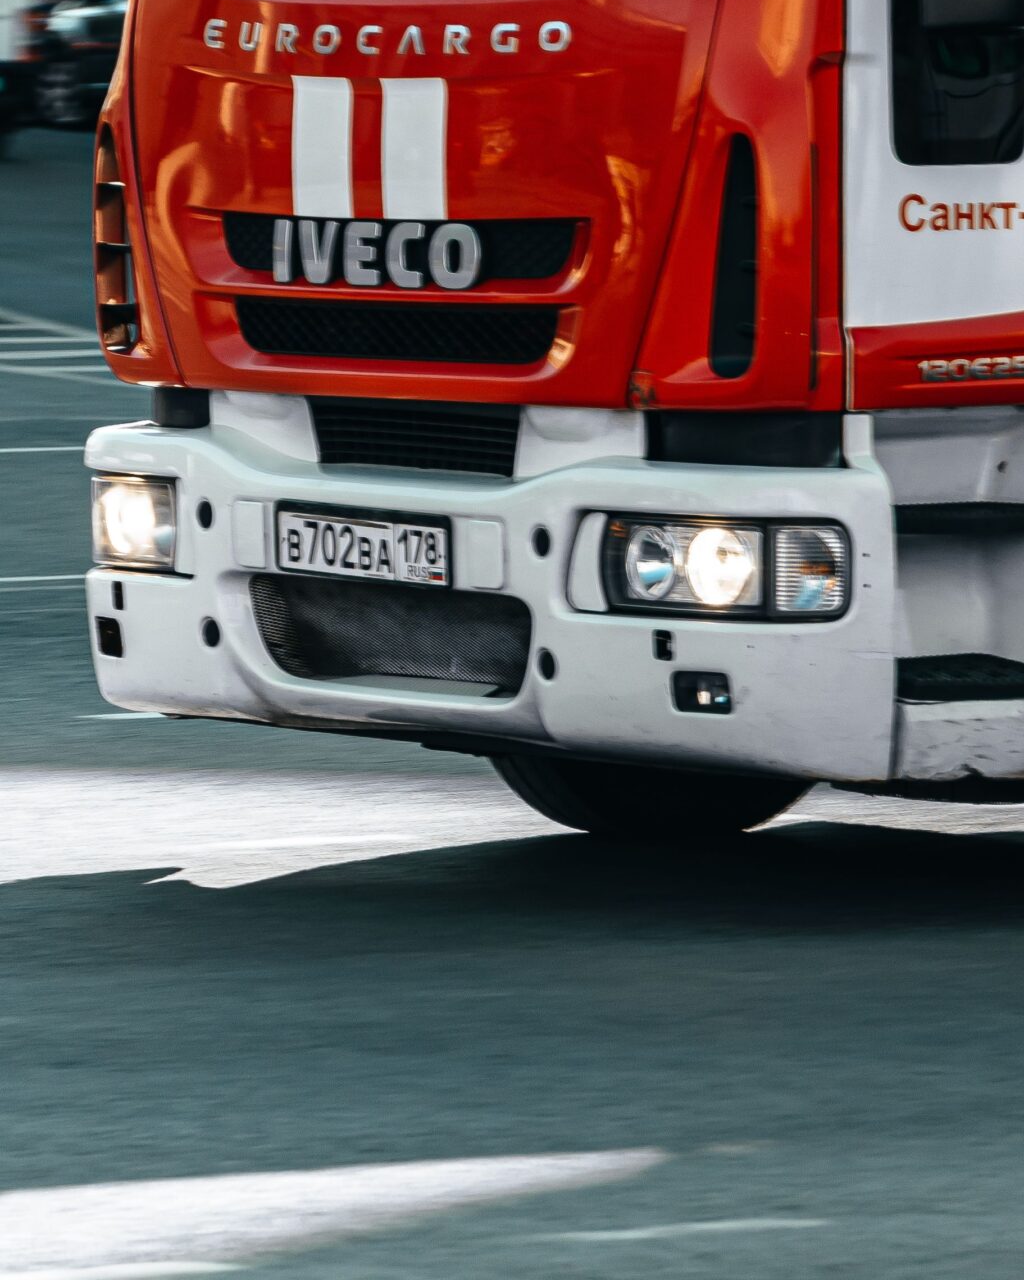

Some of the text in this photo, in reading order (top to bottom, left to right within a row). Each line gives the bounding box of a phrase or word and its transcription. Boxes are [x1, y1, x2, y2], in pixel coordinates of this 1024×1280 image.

[203, 18, 572, 55] EUROCARGO
[272, 219, 482, 290] IVECO
[398, 529, 437, 565] 178
